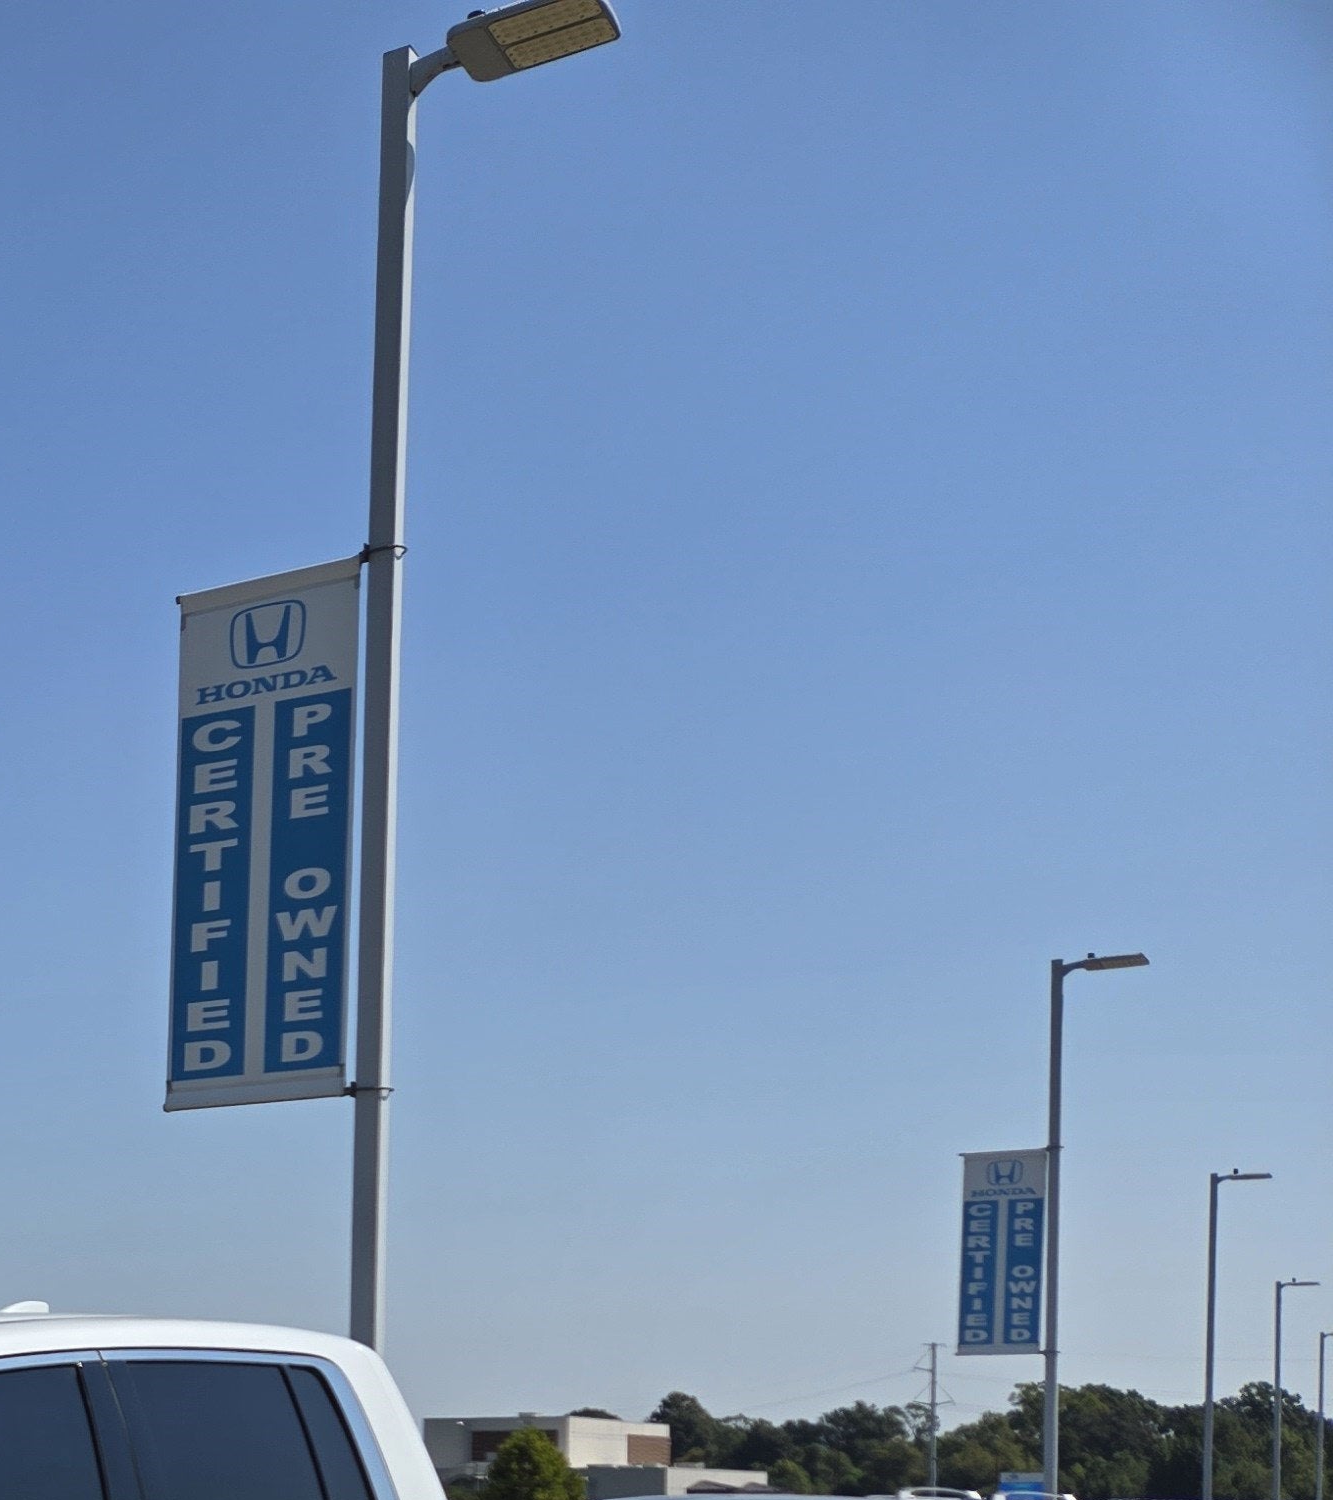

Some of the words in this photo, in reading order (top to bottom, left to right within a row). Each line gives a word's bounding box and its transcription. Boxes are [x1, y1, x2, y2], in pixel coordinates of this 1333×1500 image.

[195, 665, 337, 706] HONDA
[288, 703, 332, 820] PRE
[183, 719, 242, 1073] CERTIFIED
[276, 867, 337, 1064] OWNED
[970, 1186, 1037, 1198] HONDA
[964, 1203, 992, 1343] CERTIFIED
